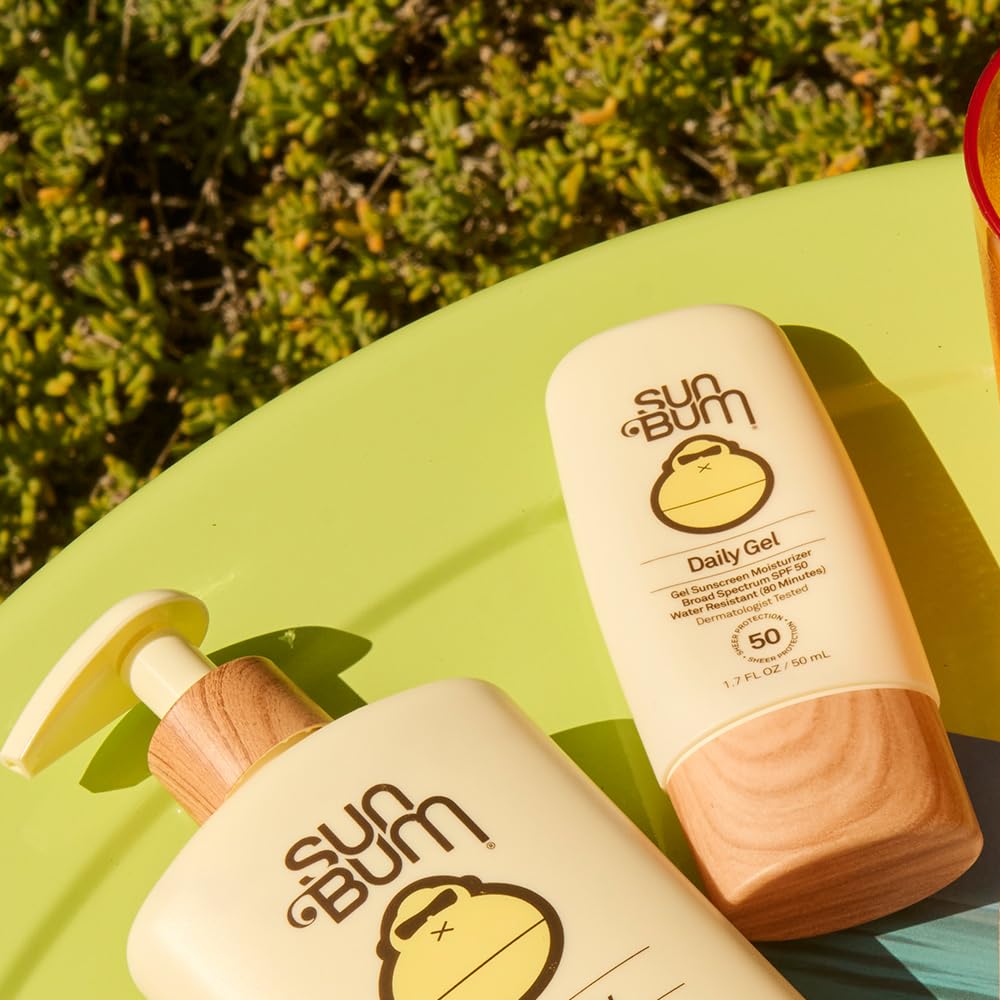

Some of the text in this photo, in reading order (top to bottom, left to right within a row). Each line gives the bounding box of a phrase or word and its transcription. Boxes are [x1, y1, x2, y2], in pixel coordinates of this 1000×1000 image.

[688, 532, 780, 573] Daily Gel
[671, 549, 812, 599] Gel Sunscreen Moisturizer
[671, 565, 825, 620] Water Resistant (80 Minutes)
[682, 562, 808, 607] Broad Spectrum SPF 50
[696, 584, 808, 626] Dermatologist Tested
[748, 628, 781, 650] 50
[724, 650, 831, 688] 1.7 FL OZ 50 mL
